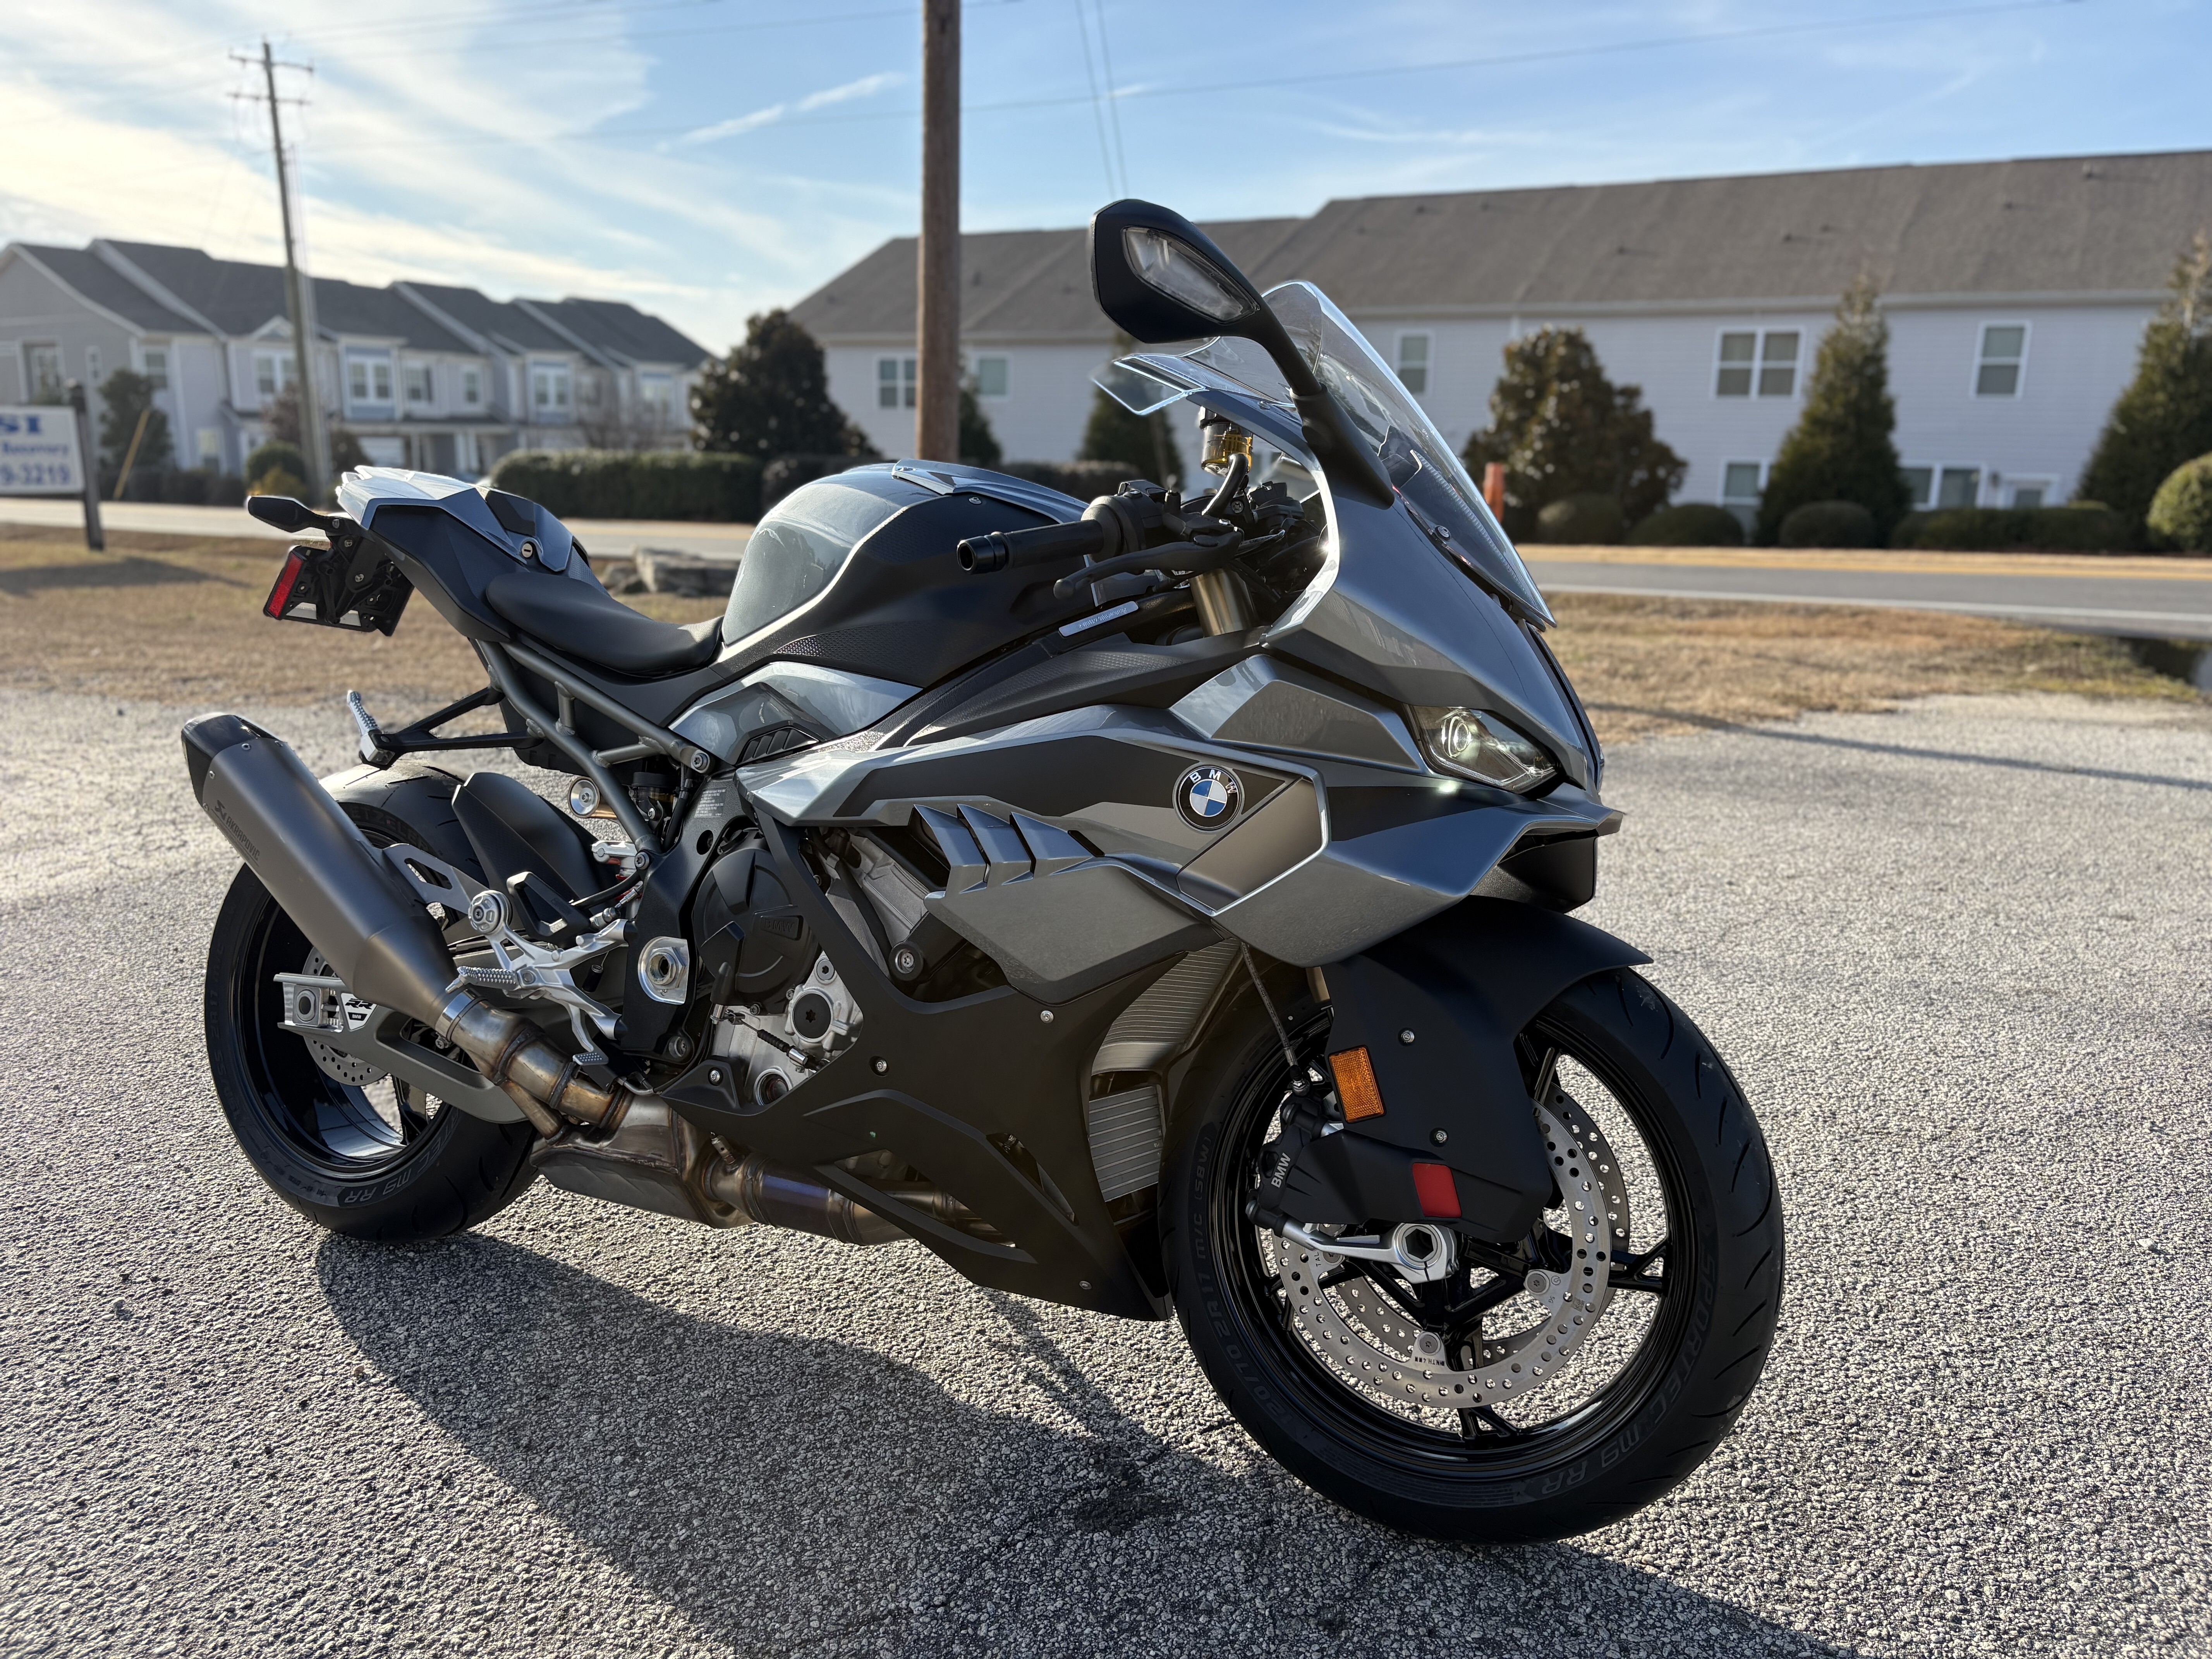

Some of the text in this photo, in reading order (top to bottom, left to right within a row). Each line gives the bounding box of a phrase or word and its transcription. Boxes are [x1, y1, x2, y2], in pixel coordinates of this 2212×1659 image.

[1189, 769, 1237, 794] BMW
[348, 807, 429, 852] ETZELER
[764, 919, 795, 933] BMW
[210, 989, 218, 1006] 17
[345, 998, 373, 1010] RR
[1195, 1137, 1211, 1200] (58W)
[1271, 1152, 1290, 1188] BMW
[345, 1187, 377, 1203] RR
[1194, 1213, 1206, 1259] M/C
[1198, 1273, 1214, 1293] 17
[1226, 1345, 1293, 1424] 120/70
[1542, 1253, 1716, 1494] SPORTEC M9 RR
